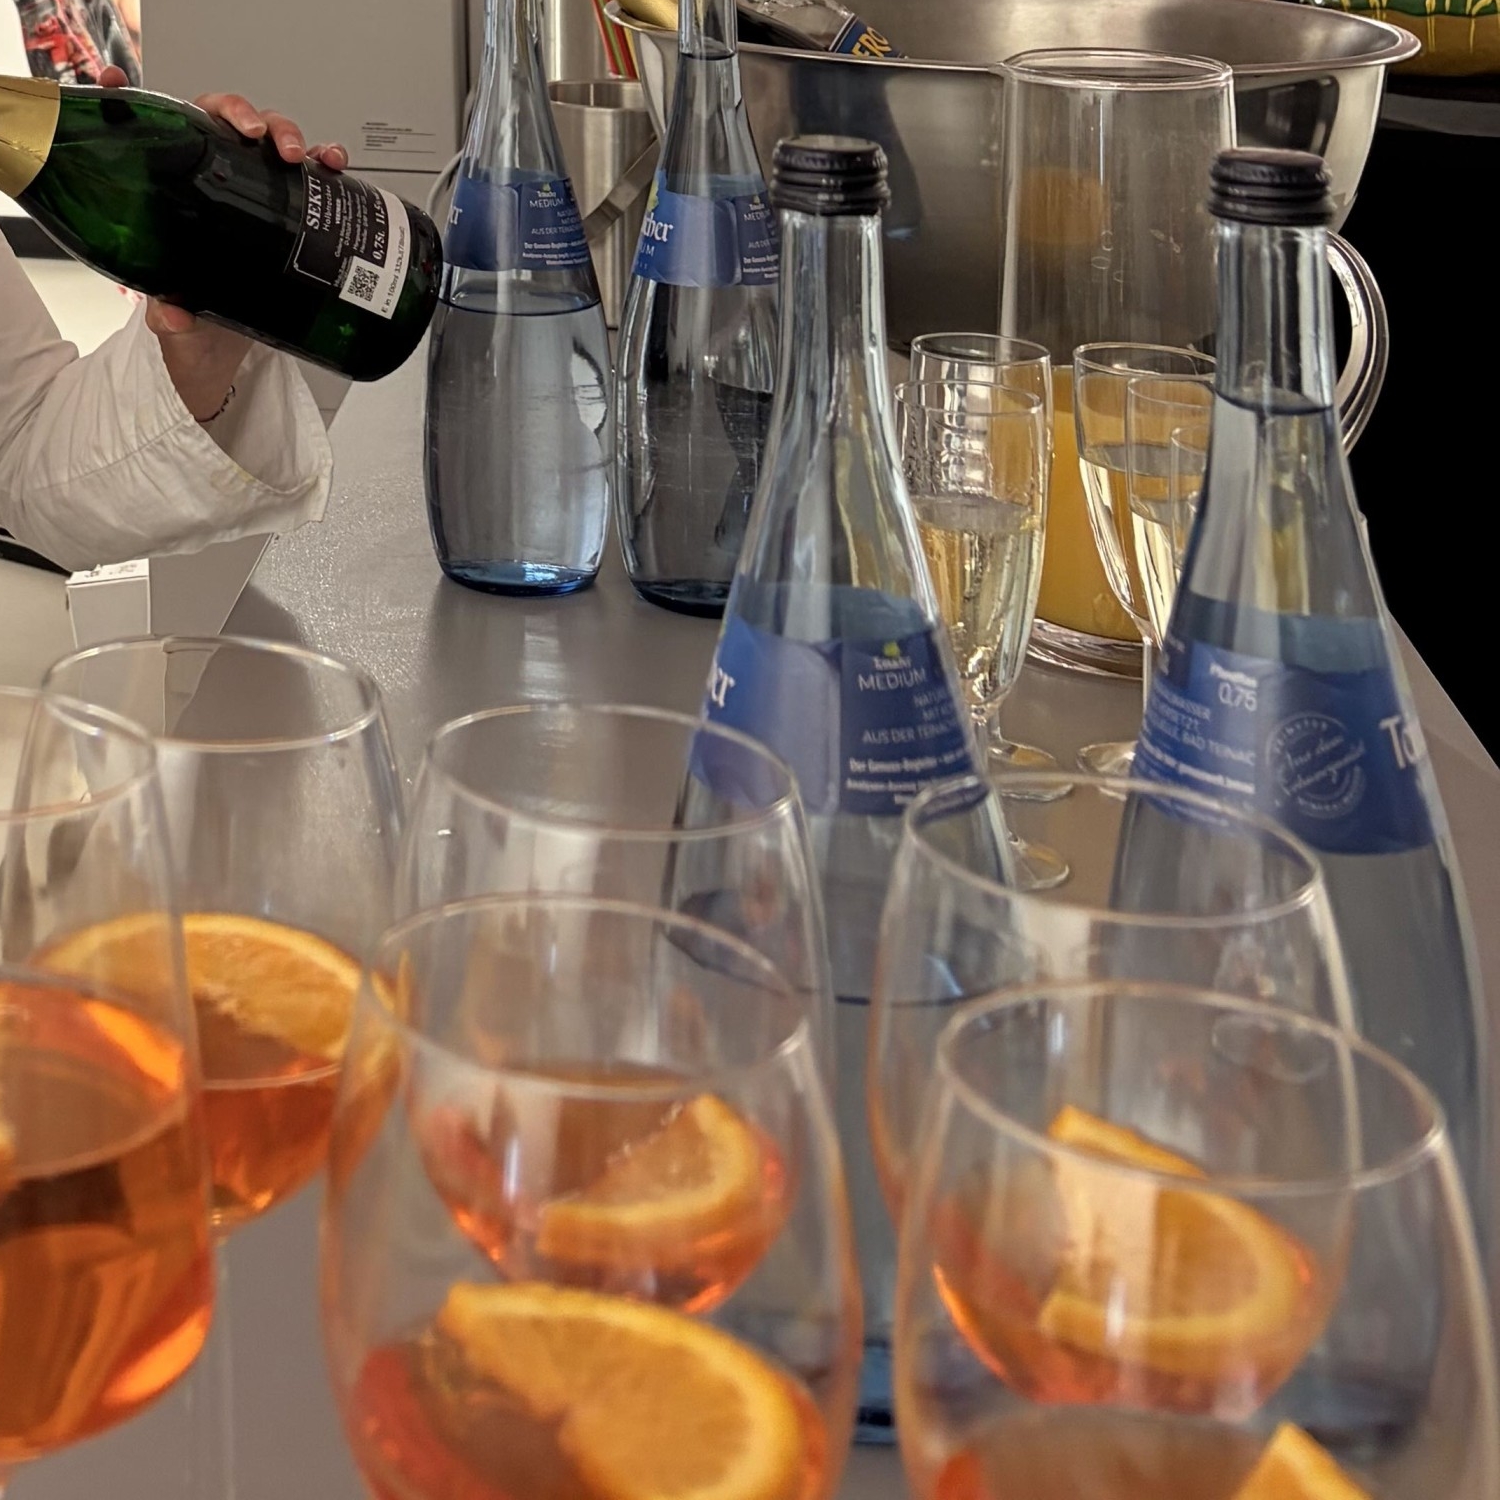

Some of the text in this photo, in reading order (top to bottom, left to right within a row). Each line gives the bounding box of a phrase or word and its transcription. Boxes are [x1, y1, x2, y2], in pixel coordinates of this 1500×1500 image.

[306, 175, 321, 231] SEKT!
[530, 198, 563, 208] MEDIUM
[857, 667, 927, 692] MEDIUM
[862, 728, 890, 745] AUS
[891, 726, 916, 744] DER
